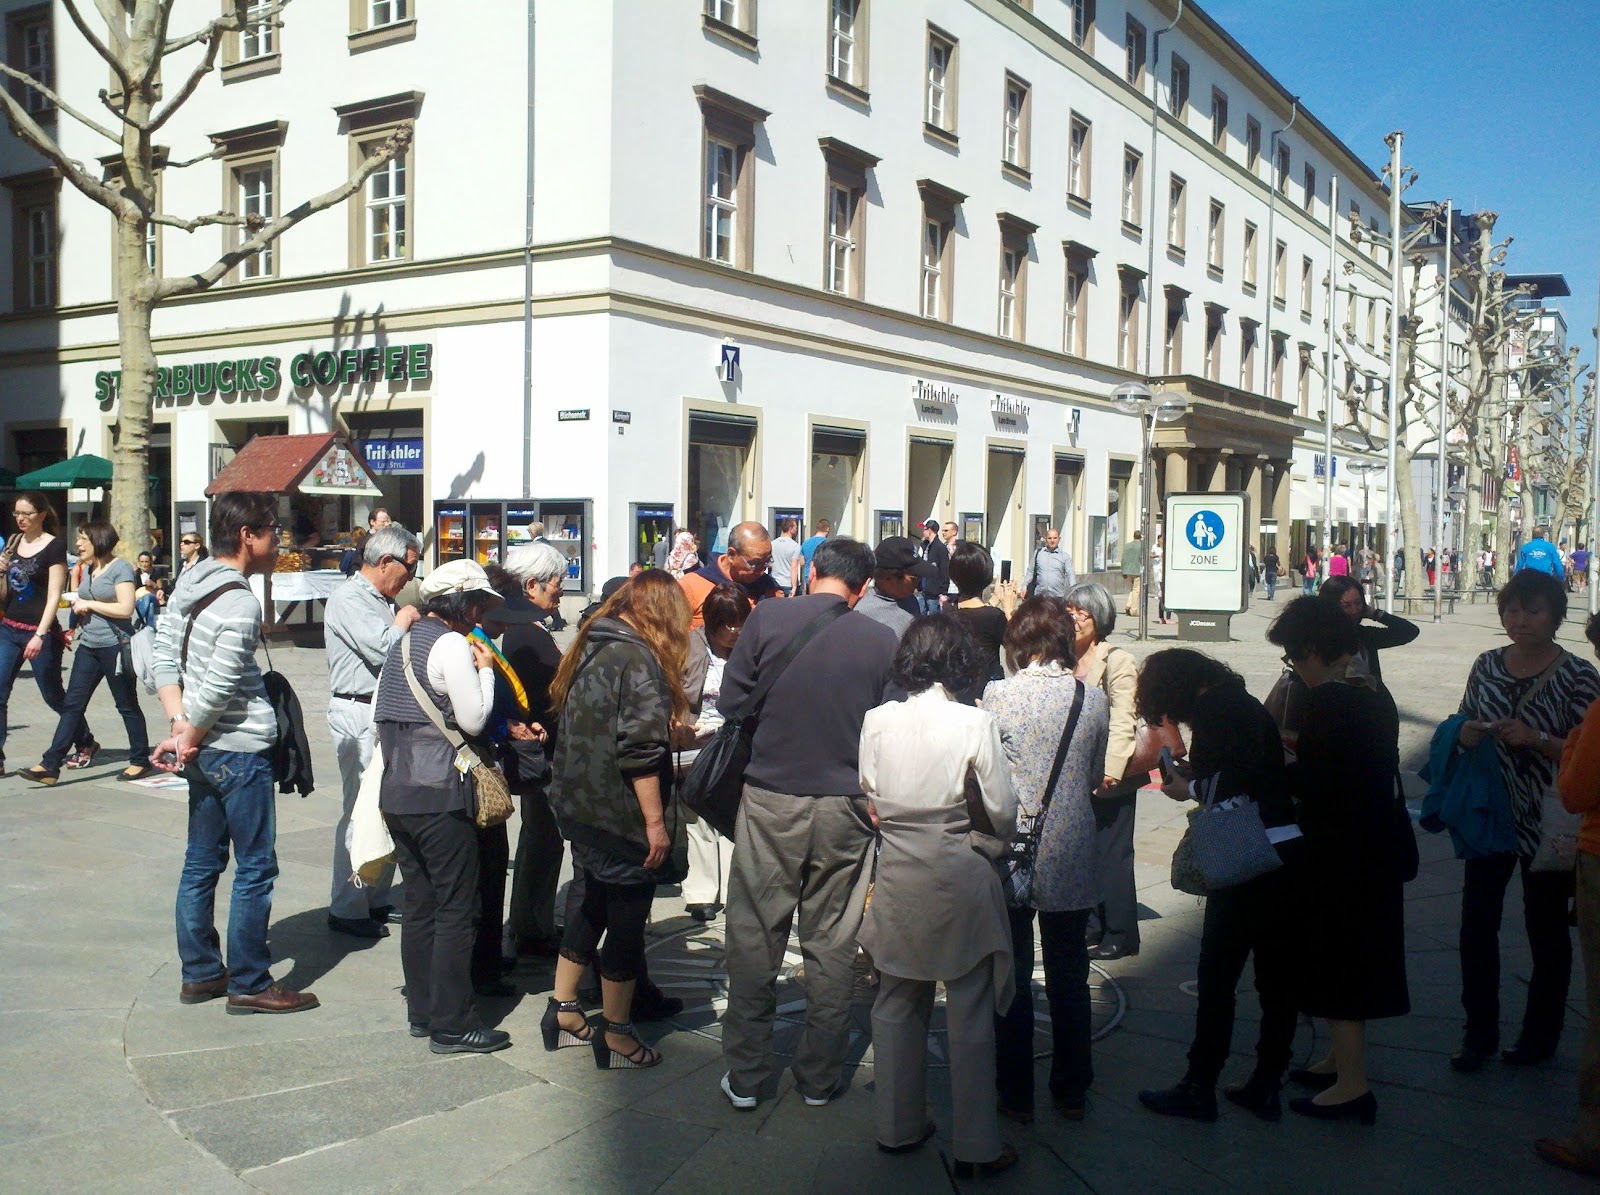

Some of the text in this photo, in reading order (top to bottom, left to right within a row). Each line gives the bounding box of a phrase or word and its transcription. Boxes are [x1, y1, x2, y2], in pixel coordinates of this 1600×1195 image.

[95, 343, 430, 401] STRBUCKS COFFEE
[1190, 555, 1218, 565] ZONE
